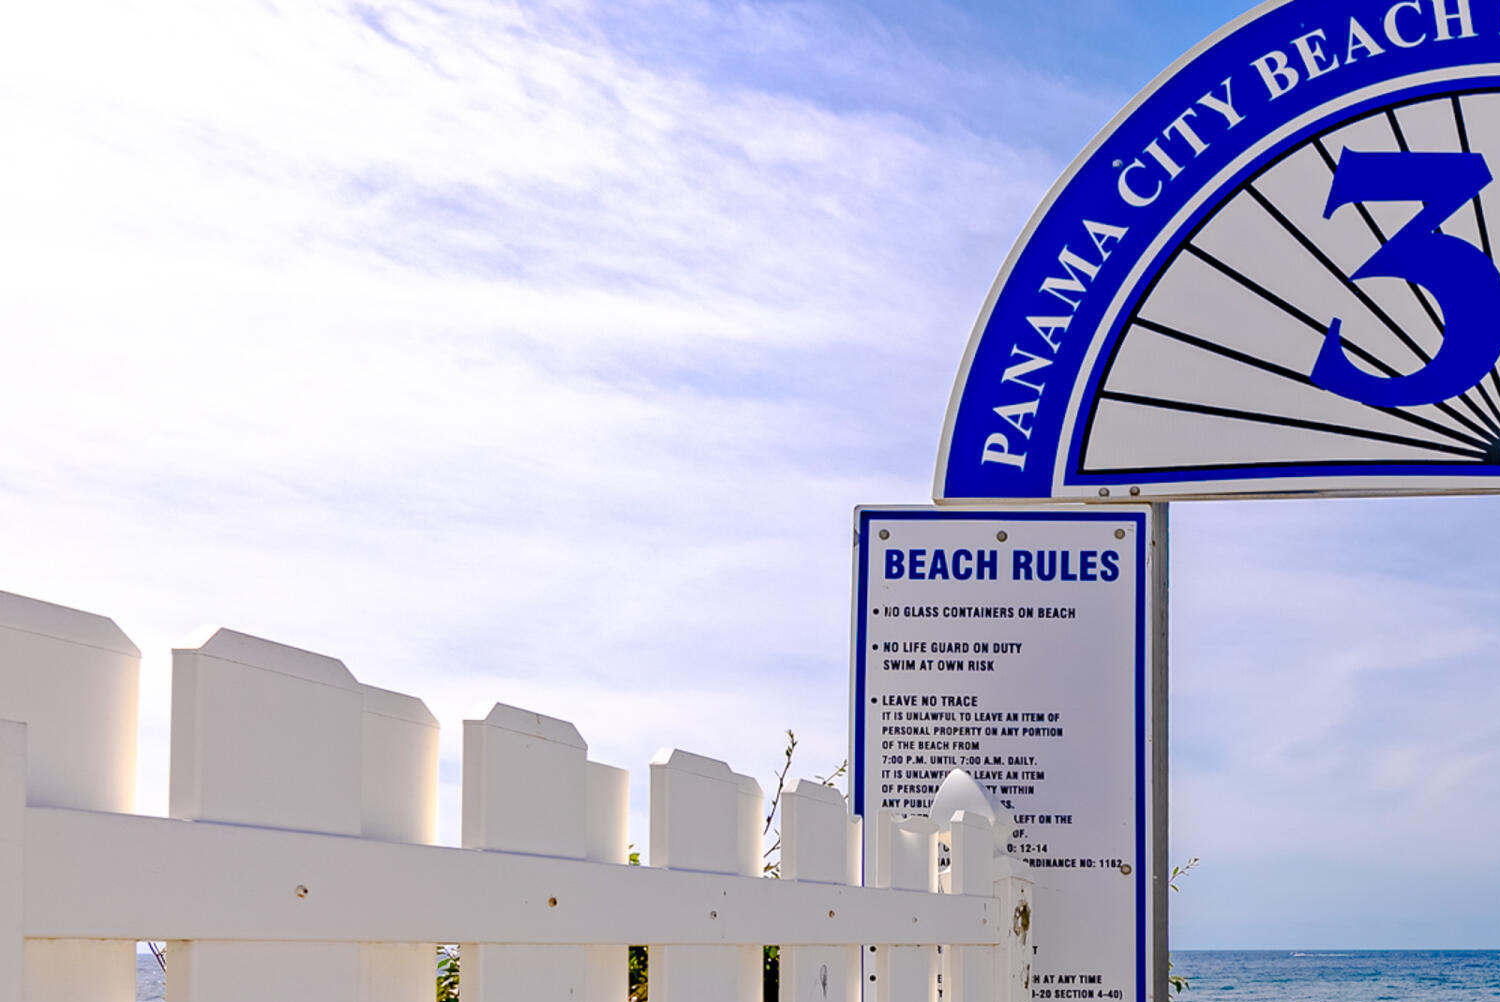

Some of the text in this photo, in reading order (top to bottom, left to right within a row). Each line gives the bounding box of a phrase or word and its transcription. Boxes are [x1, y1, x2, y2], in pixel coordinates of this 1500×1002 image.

[982, 220, 1128, 471] PANAMA
[1118, 77, 1245, 206] CITY
[1250, 0, 1477, 100] BEACH
[885, 549, 1119, 582] BEACH RULES
[885, 606, 1075, 619] NO GLASS CONTAINERS ON BEACH
[883, 642, 1022, 653] NO LIFE GUARD ON DUTY
[883, 659, 994, 671] SWIM AT OWN RISK
[882, 695, 977, 707] LEAVE NO TRACE
[882, 711, 1059, 722] IT IS UNLAWFUL TO LEAVE AN ITEM OF
[882, 726, 1063, 737] PERSONAL PROPERTY ON ANY PORTION
[882, 740, 979, 750] OF THE BEACH FROM
[882, 755, 1037, 765] 7:00 P.M. UNTIL 7:00 A.M. DAILY.
[882, 770, 891, 779] IT
[893, 770, 903, 779] IS
[906, 770, 949, 780] UNLAWF
[974, 770, 1002, 780] LEAVE
[1006, 771, 1018, 780] AN
[1022, 771, 1044, 780] ITEM
[882, 784, 894, 794] OF
[897, 785, 939, 794] PERSONA
[1000, 785, 1034, 794] WITHIN
[882, 799, 900, 808] ANY
[1014, 814, 1072, 824] LEFT ON THE
[1020, 844, 1048, 853] 12-14
[1079, 859, 1095, 867] NO:
[1043, 975, 1054, 983] AT
[1058, 975, 1076, 983] ANY
[1079, 975, 1101, 984] TIME
[1054, 989, 1094, 999] SECTION
[1097, 990, 1122, 1000] 4-40)
